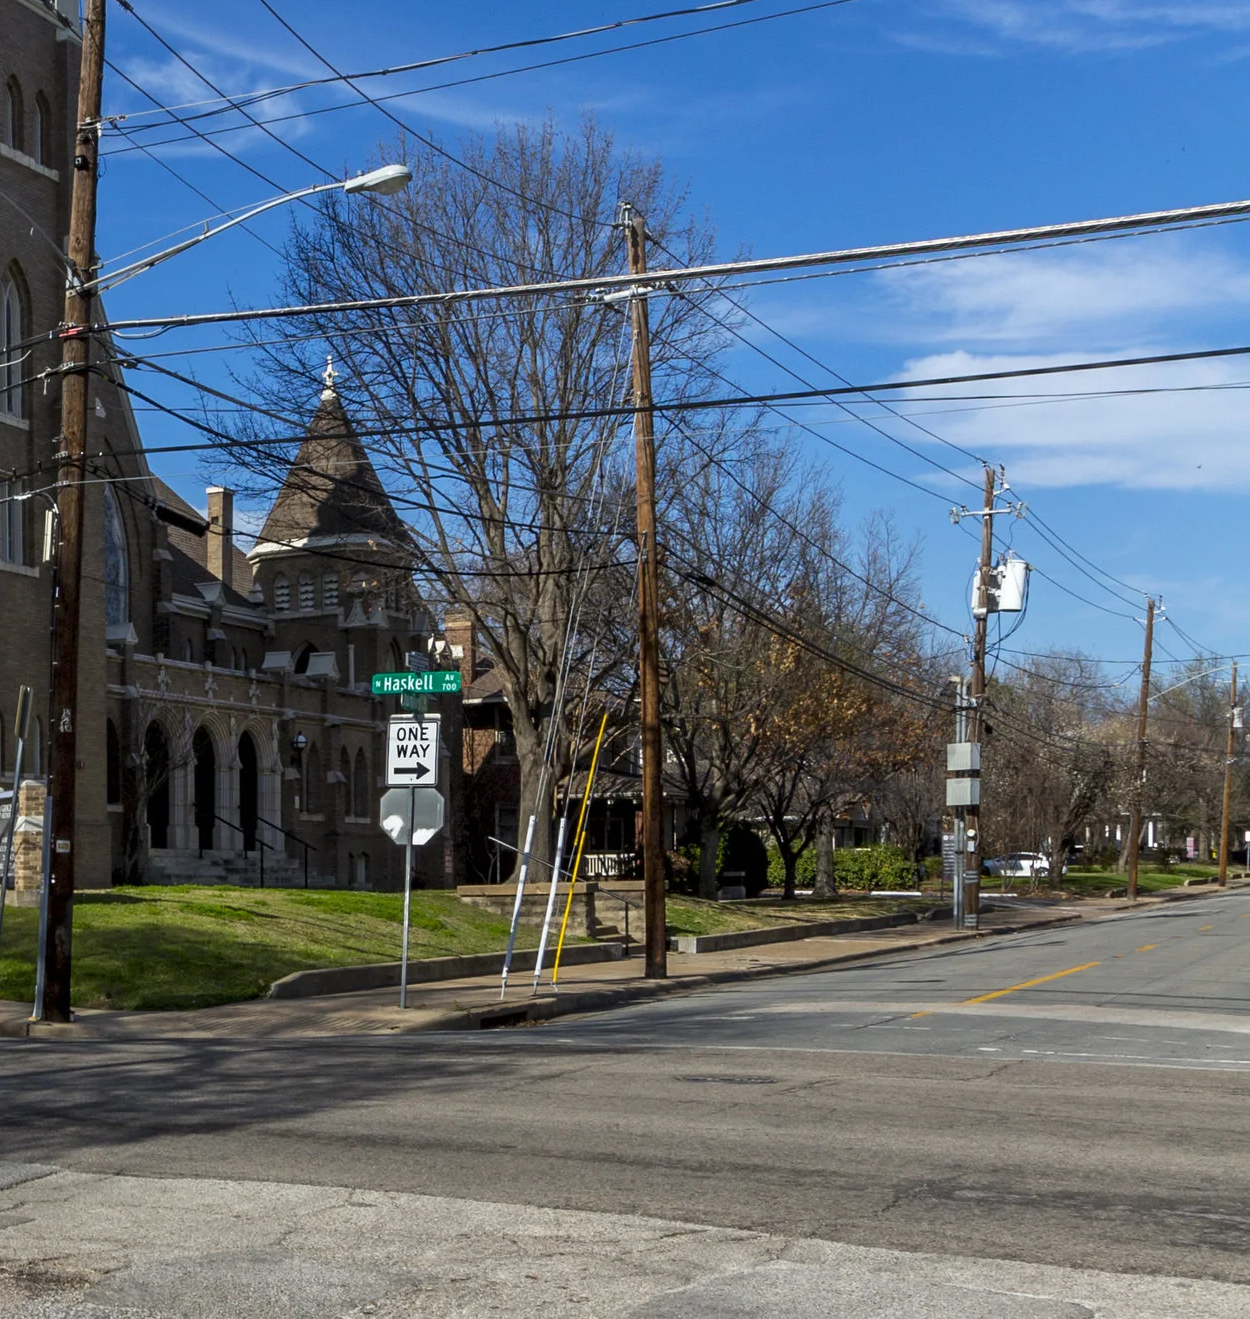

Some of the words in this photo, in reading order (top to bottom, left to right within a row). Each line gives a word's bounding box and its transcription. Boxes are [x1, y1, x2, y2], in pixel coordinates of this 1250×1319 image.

[383, 675, 433, 691] Haskell
[442, 683, 457, 691] 700
[396, 727, 429, 741] ONE
[396, 744, 430, 758] WAY
